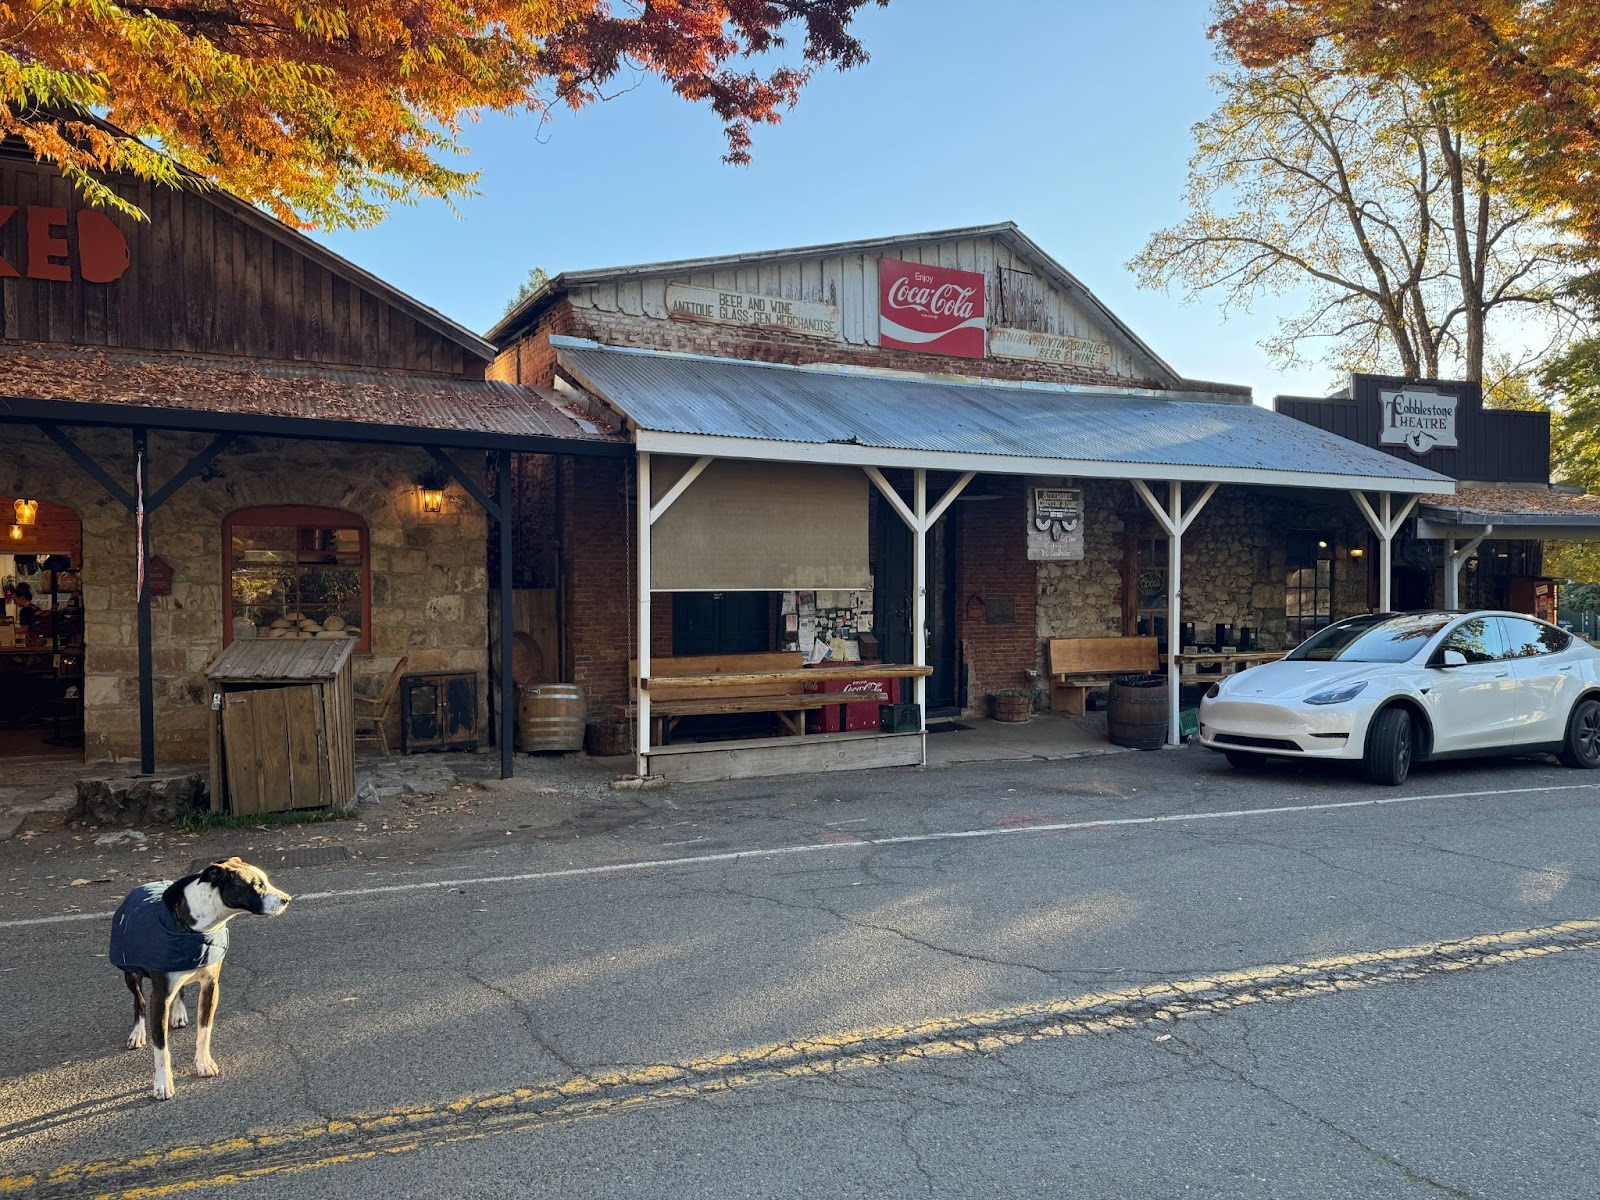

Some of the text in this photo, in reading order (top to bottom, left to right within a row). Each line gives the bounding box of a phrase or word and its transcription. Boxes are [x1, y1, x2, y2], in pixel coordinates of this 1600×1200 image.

[914, 271, 934, 283] Enjoy
[719, 293, 793, 315] BEER AND WINE
[887, 276, 977, 319] Coca-Cola
[673, 300, 714, 318] ANTIQUE
[776, 315, 835, 333] MERCHANDISE
[1039, 347, 1061, 360] BEER
[1073, 341, 1106, 355] SUPPLIES
[1386, 400, 1447, 429] THEATRE
[1393, 394, 1453, 418] Cobblestone
